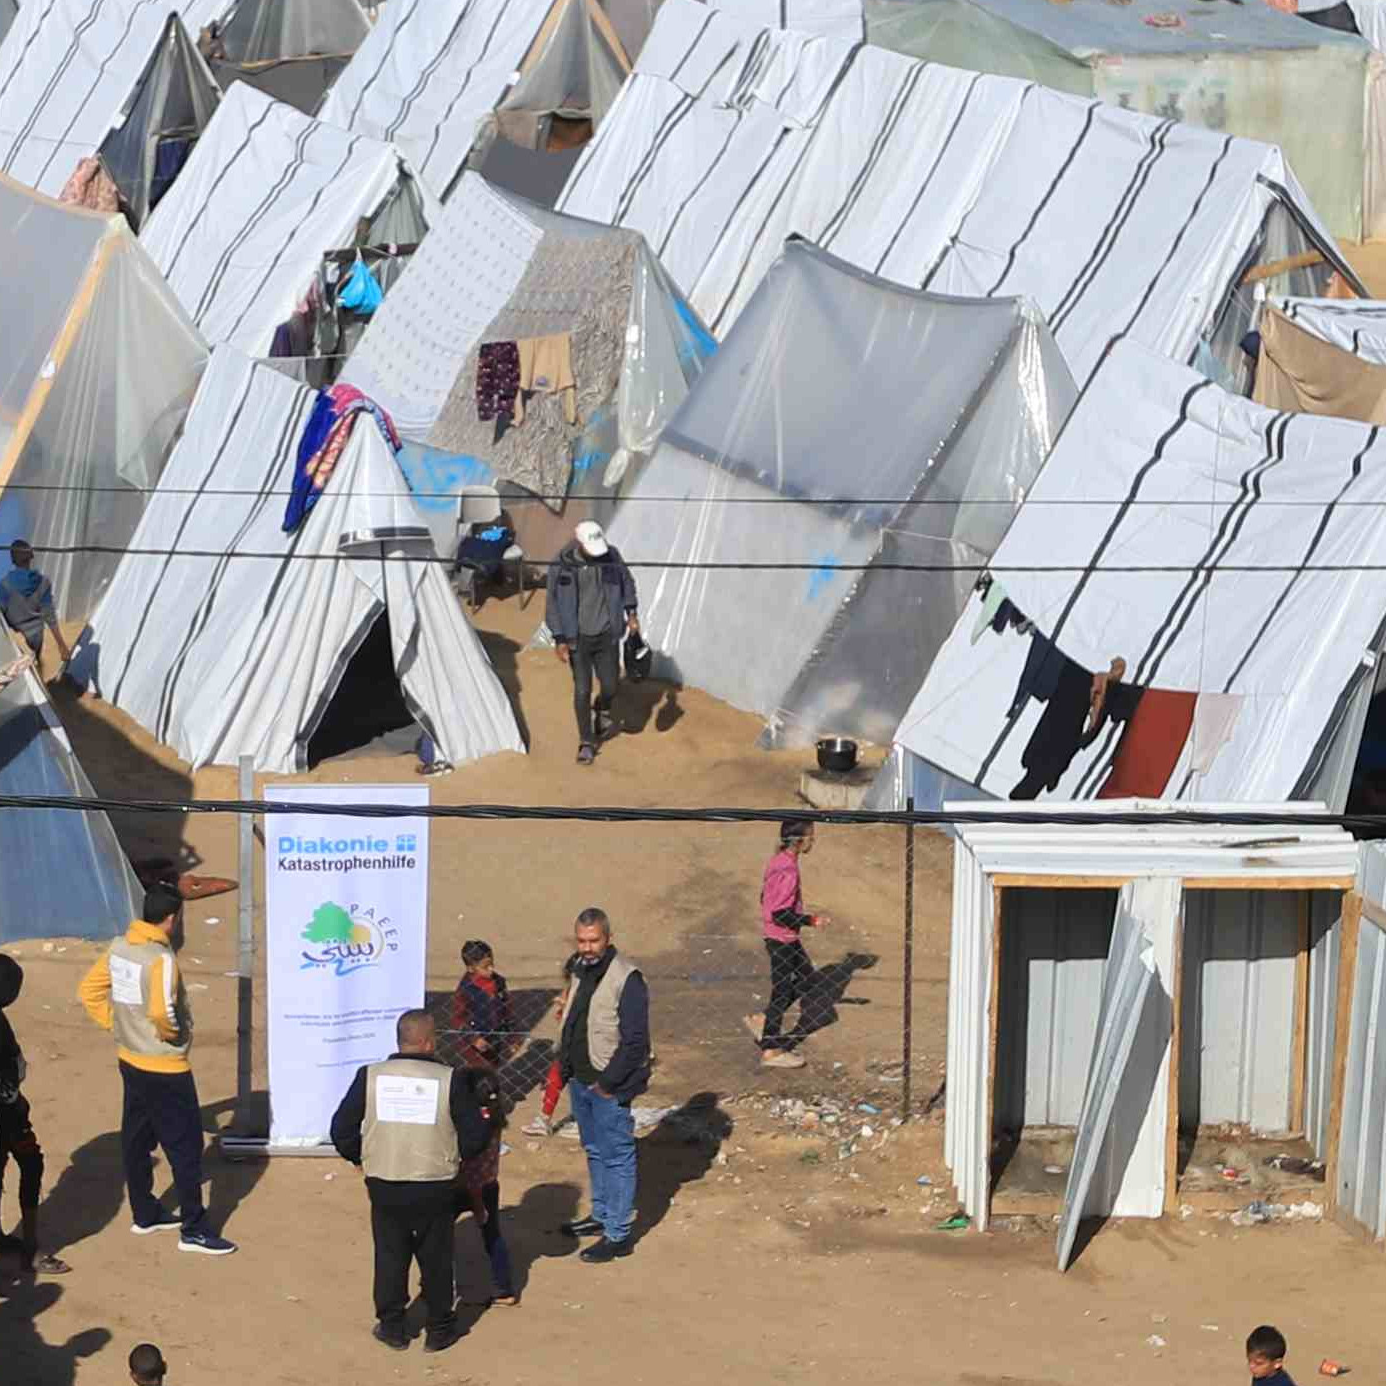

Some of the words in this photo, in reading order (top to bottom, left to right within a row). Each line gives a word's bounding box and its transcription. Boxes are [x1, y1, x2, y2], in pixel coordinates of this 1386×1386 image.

[278, 836, 389, 854] Diakonie
[277, 855, 416, 872] Katastrophenhilfe
[349, 903, 399, 952] PAEEP
